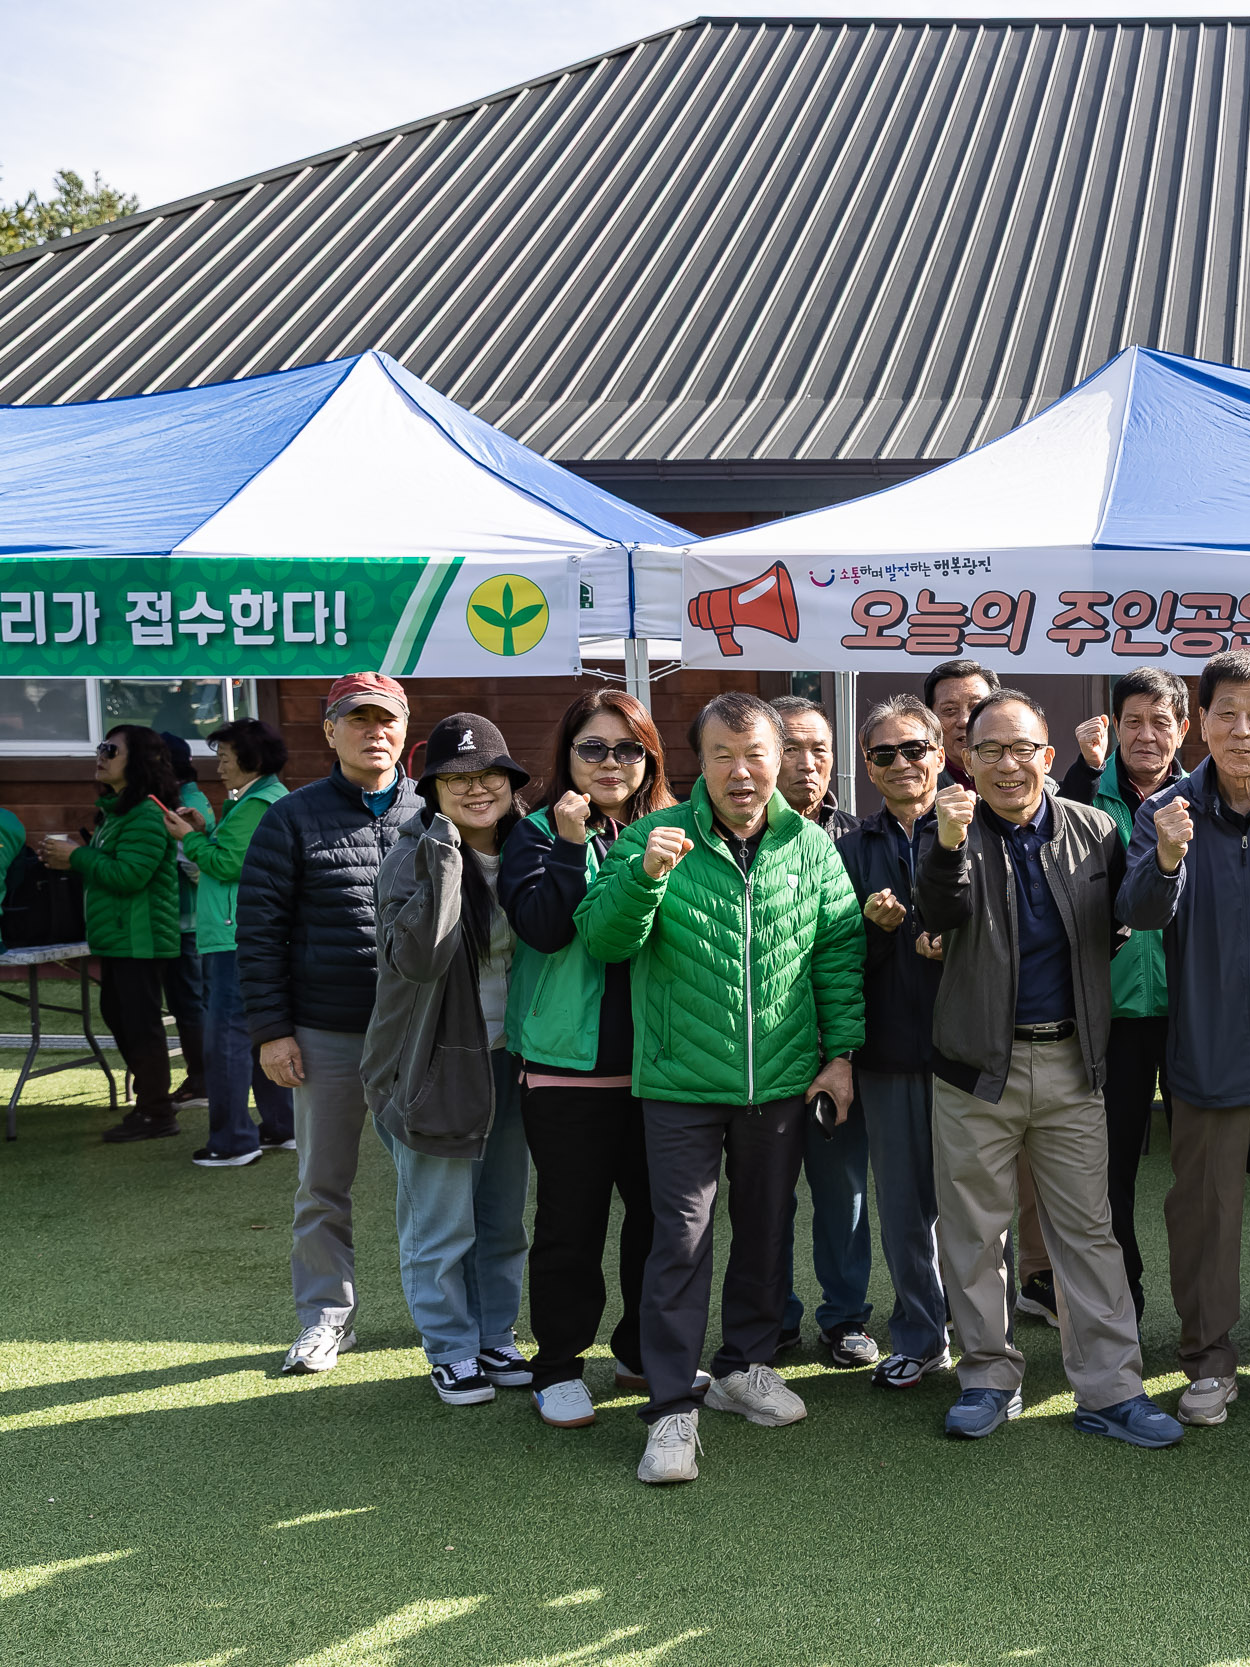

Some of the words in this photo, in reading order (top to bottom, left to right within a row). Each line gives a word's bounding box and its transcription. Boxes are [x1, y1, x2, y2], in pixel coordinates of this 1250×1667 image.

[840, 564, 883, 585] 소통하며
[885, 562, 931, 582] 발전하는
[934, 556, 992, 577] 행복광진
[0, 591, 100, 646] 리가
[125, 590, 347, 646] 접수한다!
[840, 588, 1037, 656] 오늘의
